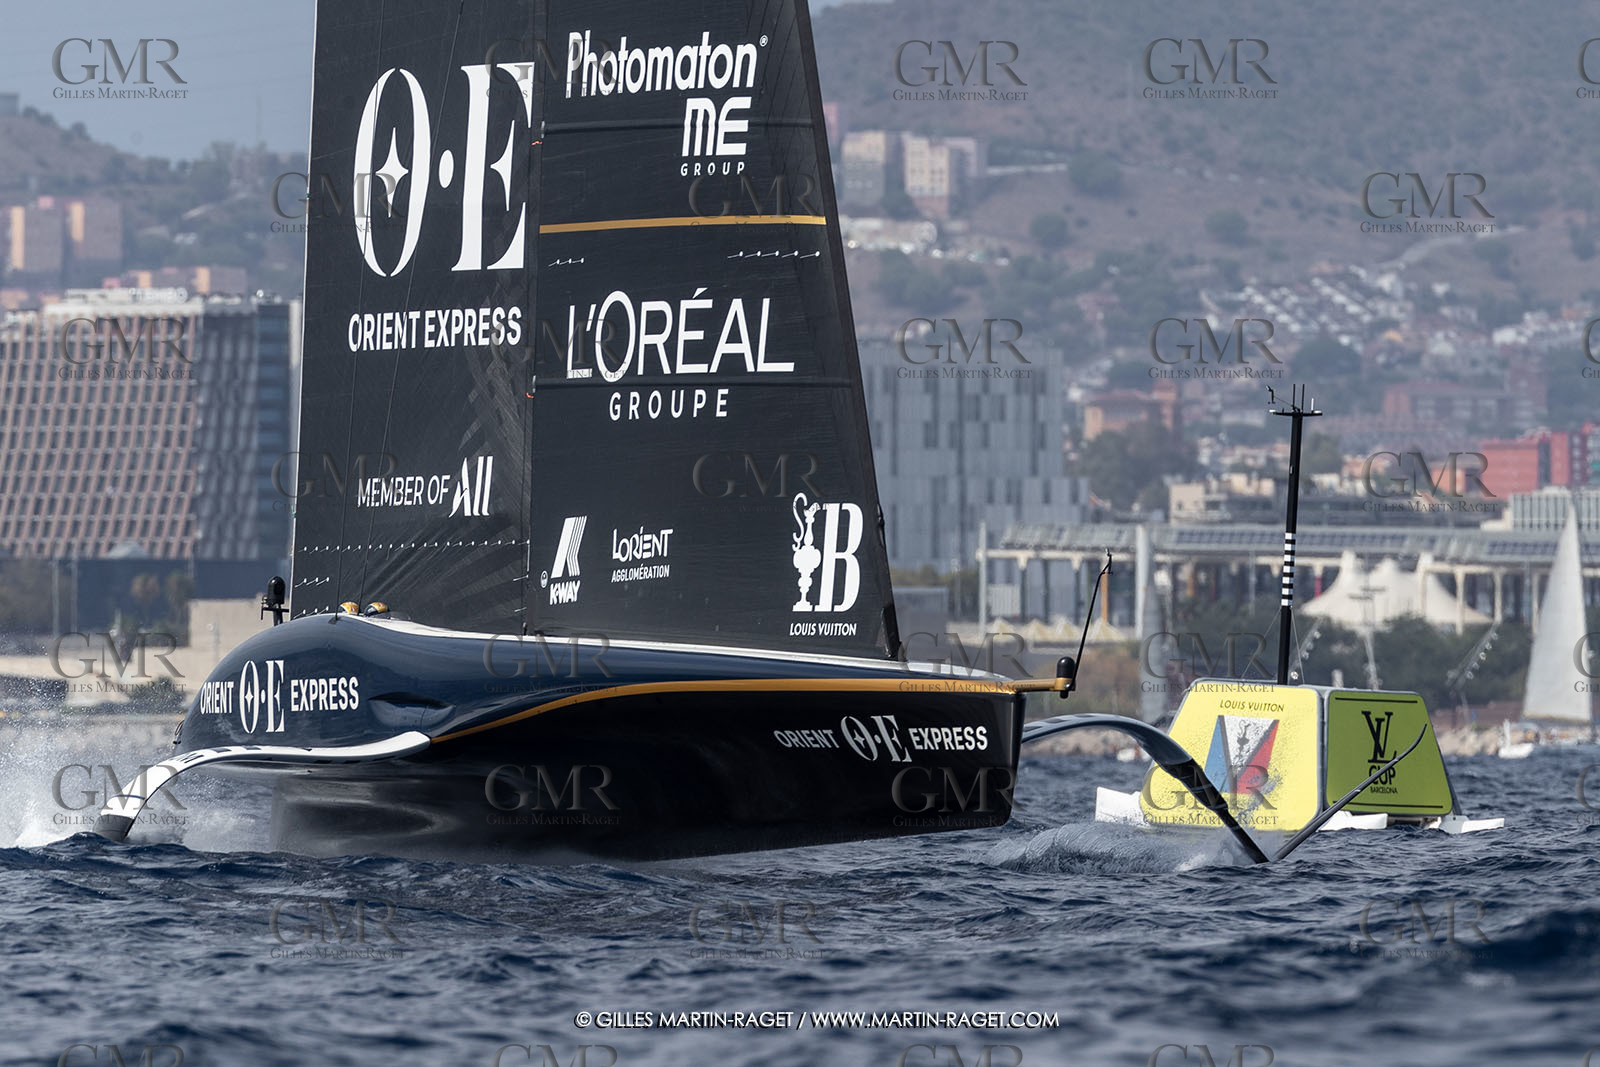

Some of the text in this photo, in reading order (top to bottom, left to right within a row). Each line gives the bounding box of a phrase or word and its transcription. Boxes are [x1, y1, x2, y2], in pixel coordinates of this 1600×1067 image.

[680, 162, 745, 177] GROUP
[349, 306, 522, 352] ORIENT EXPRESS
[609, 388, 729, 421] GROUPE
[357, 475, 424, 507] MEMBER
[427, 474, 451, 505] OF
[611, 563, 670, 583] AGGLOMÉRATION
[789, 623, 857, 636] LOUIS VUITTON
[200, 681, 235, 715] ORIENT
[290, 676, 359, 712] EXPRESS
[1219, 699, 1285, 712] LOUIS VUITTON
[773, 730, 840, 749] ORIENT
[908, 726, 988, 751] EXPRESS
